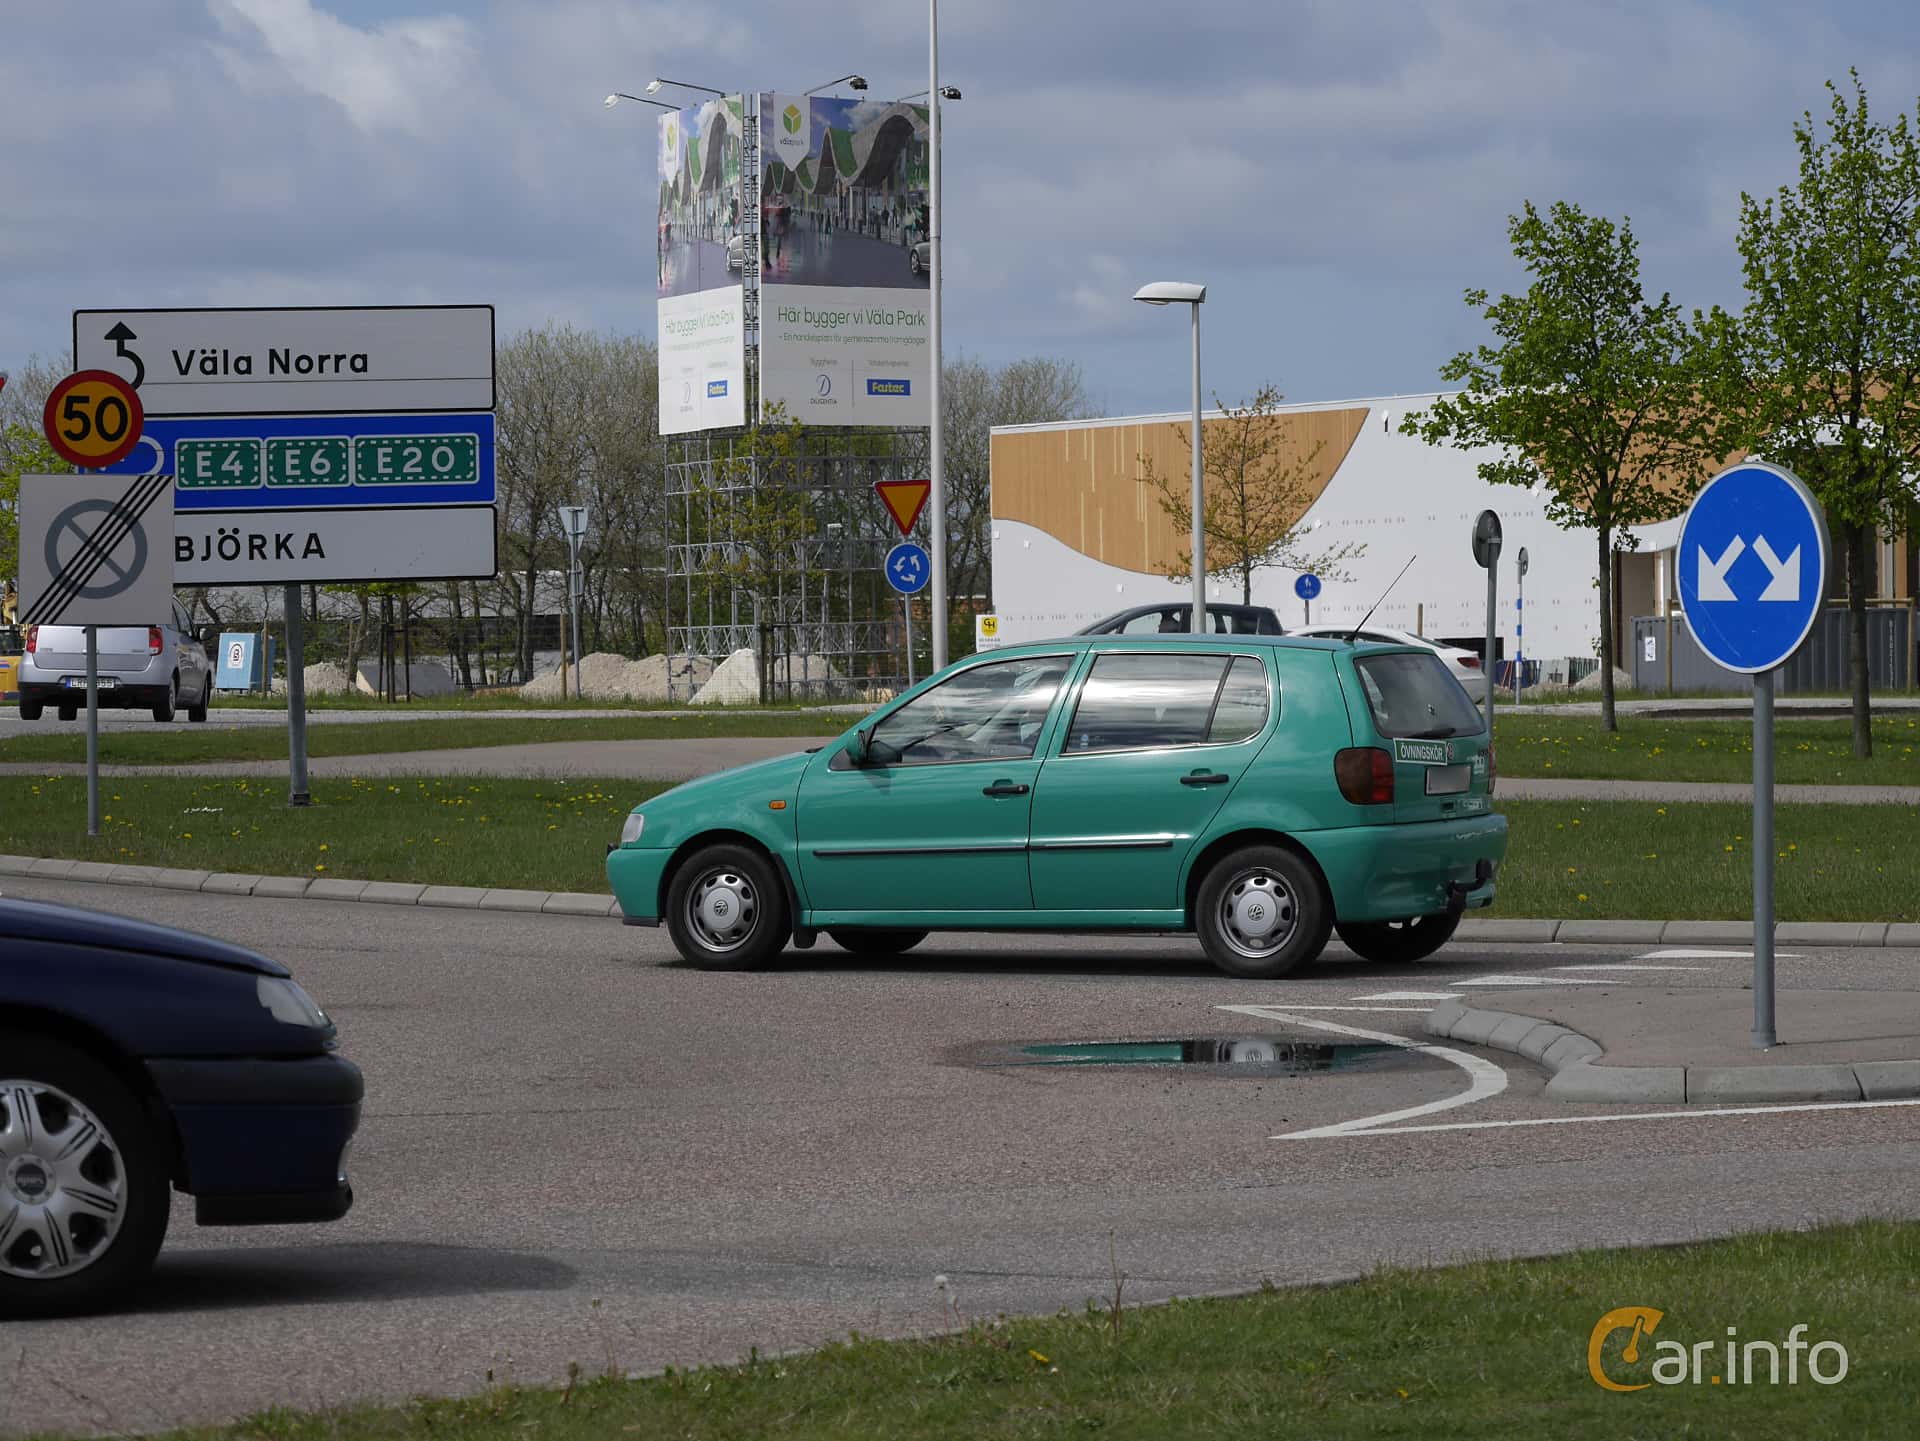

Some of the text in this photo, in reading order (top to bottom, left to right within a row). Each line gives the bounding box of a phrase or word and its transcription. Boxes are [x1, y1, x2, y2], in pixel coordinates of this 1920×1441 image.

[778, 307, 926, 329] Här bygger vi Väla Park
[172, 347, 369, 376] Väla Norra
[63, 396, 129, 442] 50
[174, 527, 326, 563] BJÖRKA
[1400, 743, 1443, 761] ÖVNINGSKÖR
